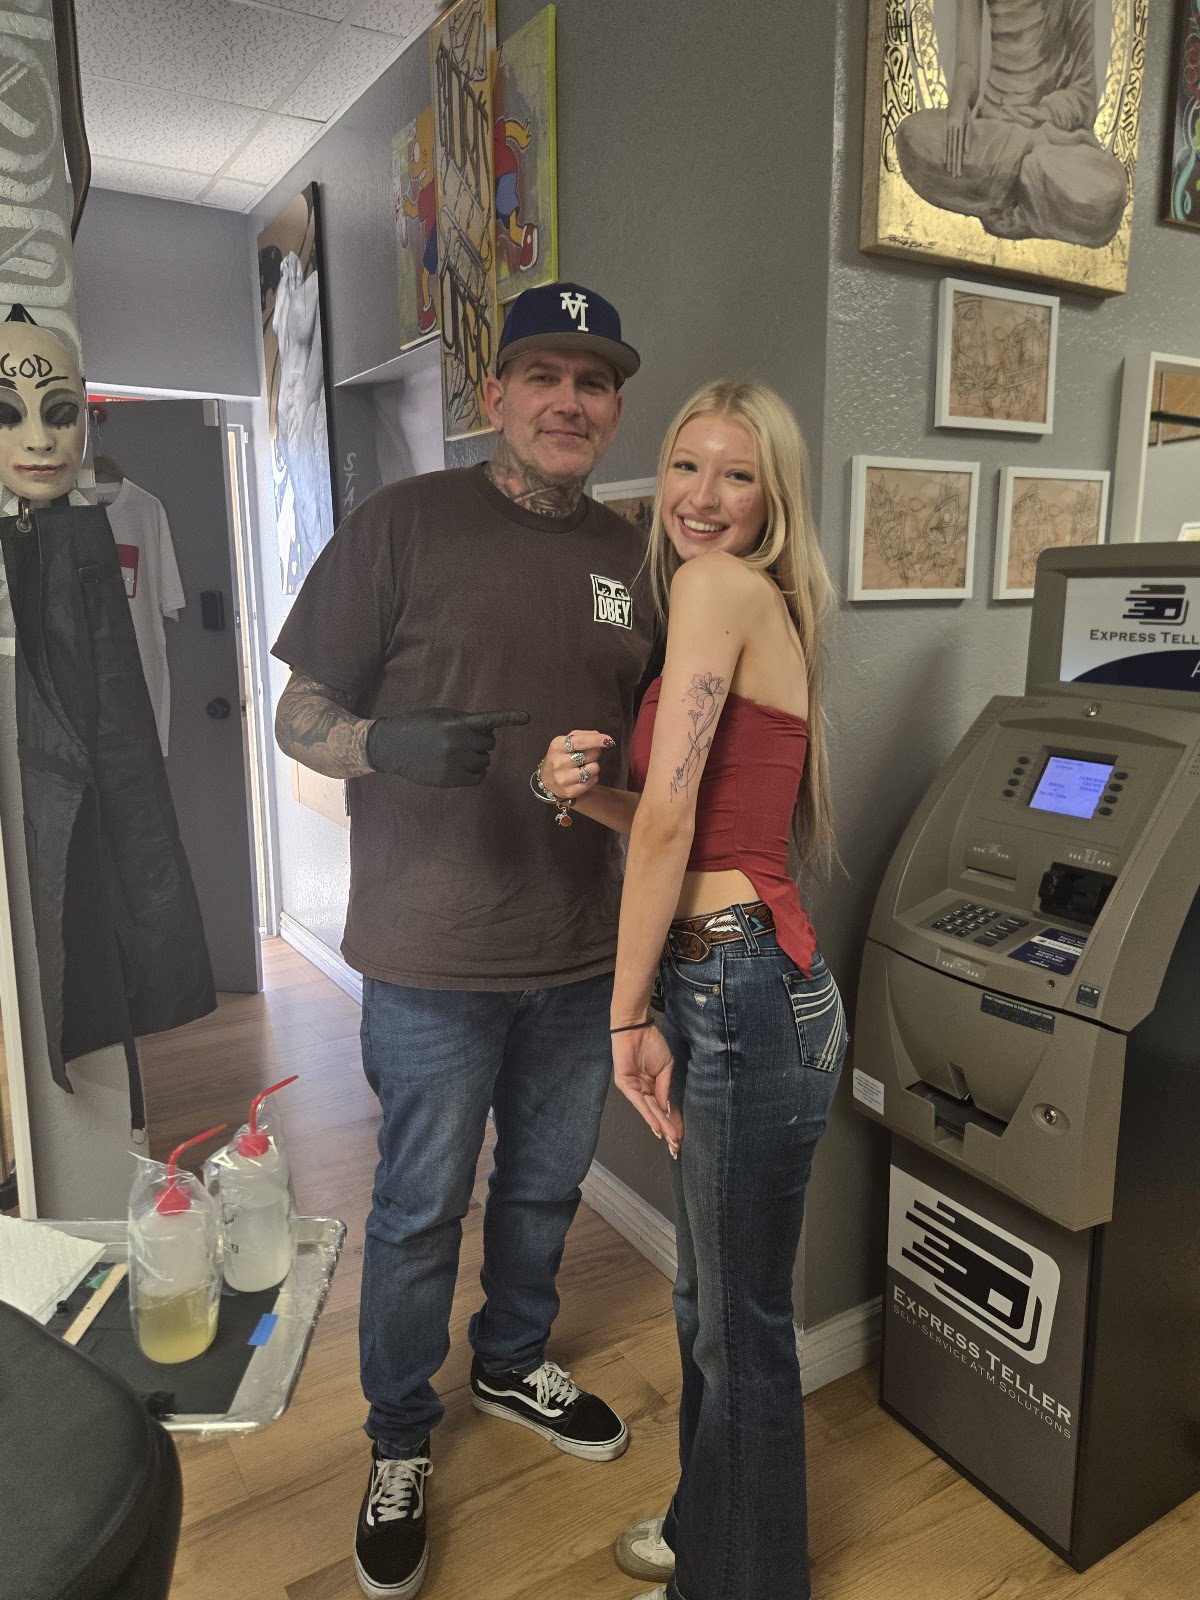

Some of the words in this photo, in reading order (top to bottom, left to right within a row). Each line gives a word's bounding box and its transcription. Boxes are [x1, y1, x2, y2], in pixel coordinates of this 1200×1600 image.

[1, 353, 53, 378] GOD
[344, 453, 359, 515] STA
[598, 596, 630, 626] OBEY
[1090, 629, 1156, 643] EXPRESS
[893, 1304, 967, 1364] SELF-SERVICE
[970, 1361, 995, 1385] ATM
[999, 1381, 1071, 1439] SOLUTIONS
[894, 1285, 980, 1359] EXPRESS
[986, 1349, 1072, 1425] TELLER
